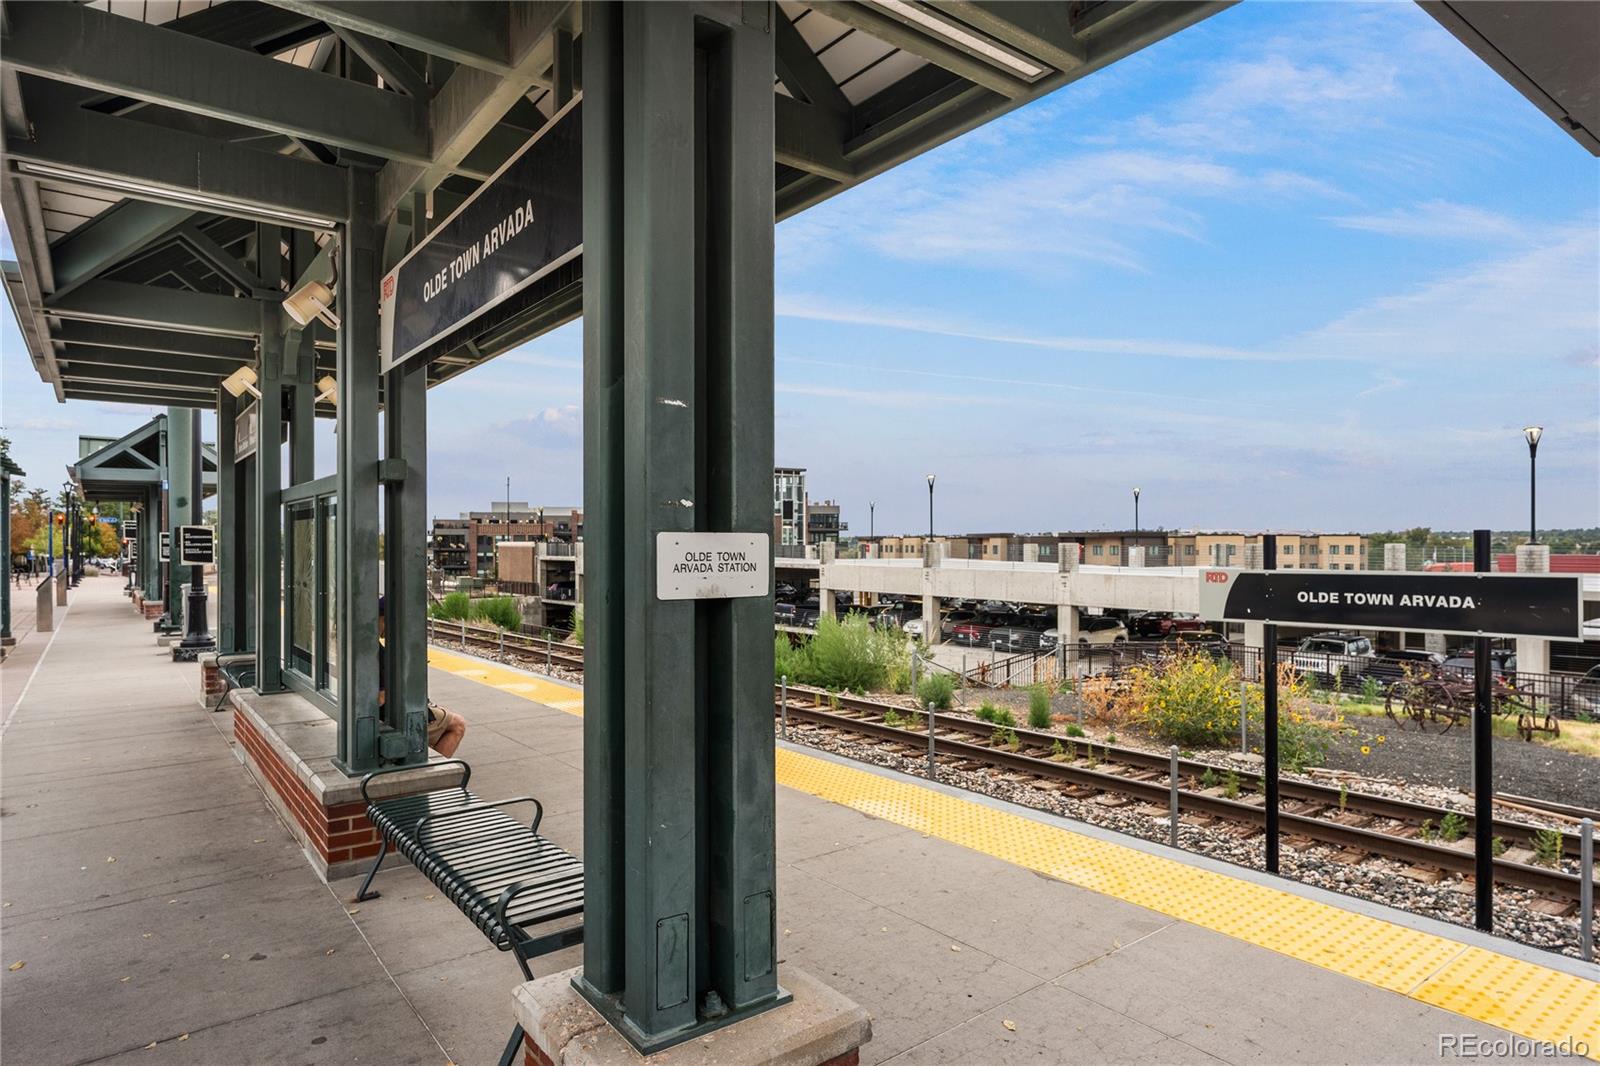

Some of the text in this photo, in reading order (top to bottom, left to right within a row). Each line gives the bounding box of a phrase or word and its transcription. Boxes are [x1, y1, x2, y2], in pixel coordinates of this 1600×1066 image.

[423, 199, 534, 302] OLDE TOWN ARVADA
[685, 552, 746, 562] OLDE TOWN
[673, 562, 757, 573] ARVADA STATION
[1297, 591, 1475, 609] OLDE TOWN ARVADA
